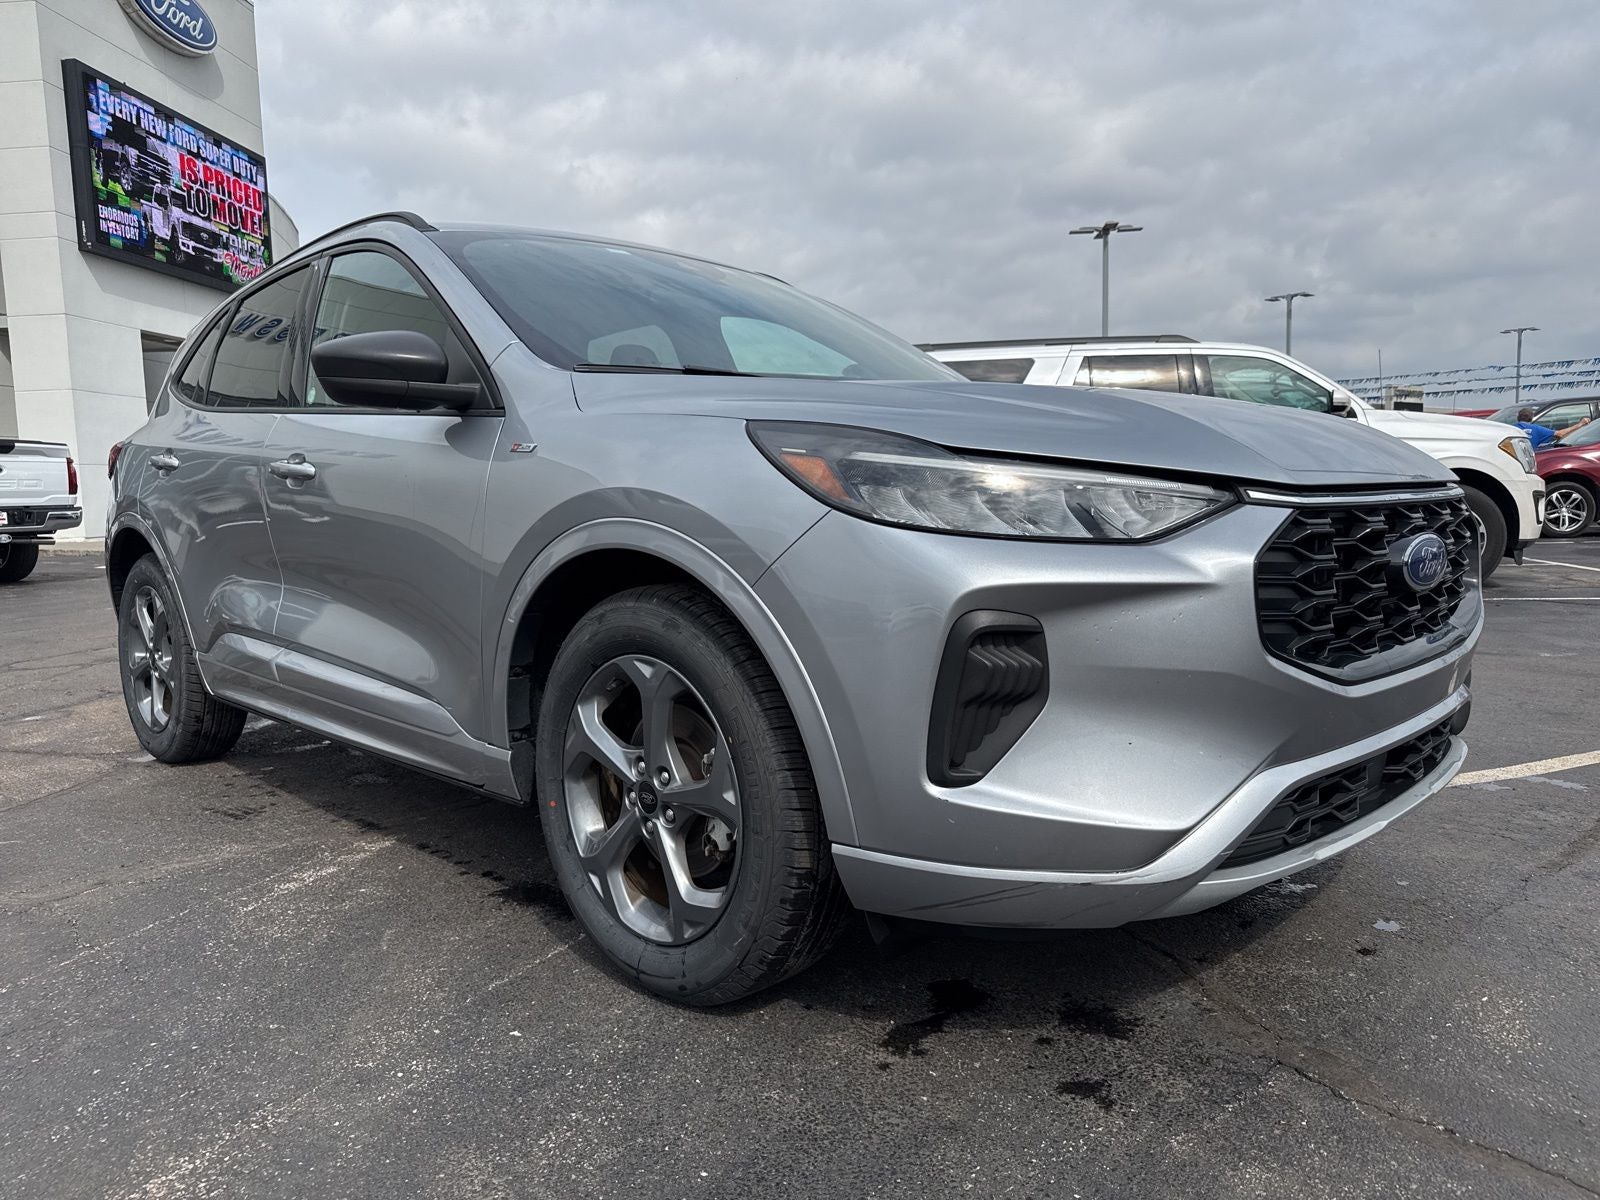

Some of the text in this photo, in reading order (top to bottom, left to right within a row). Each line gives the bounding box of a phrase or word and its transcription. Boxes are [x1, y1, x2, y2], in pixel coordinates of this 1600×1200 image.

[98, 89, 257, 182] EVERY NEW FORD SUPER DUTY
[177, 151, 264, 215] IS PRICED
[182, 181, 264, 240] TO MOVE!
[100, 219, 139, 241] INVENTORY
[219, 230, 266, 268] TRUCK
